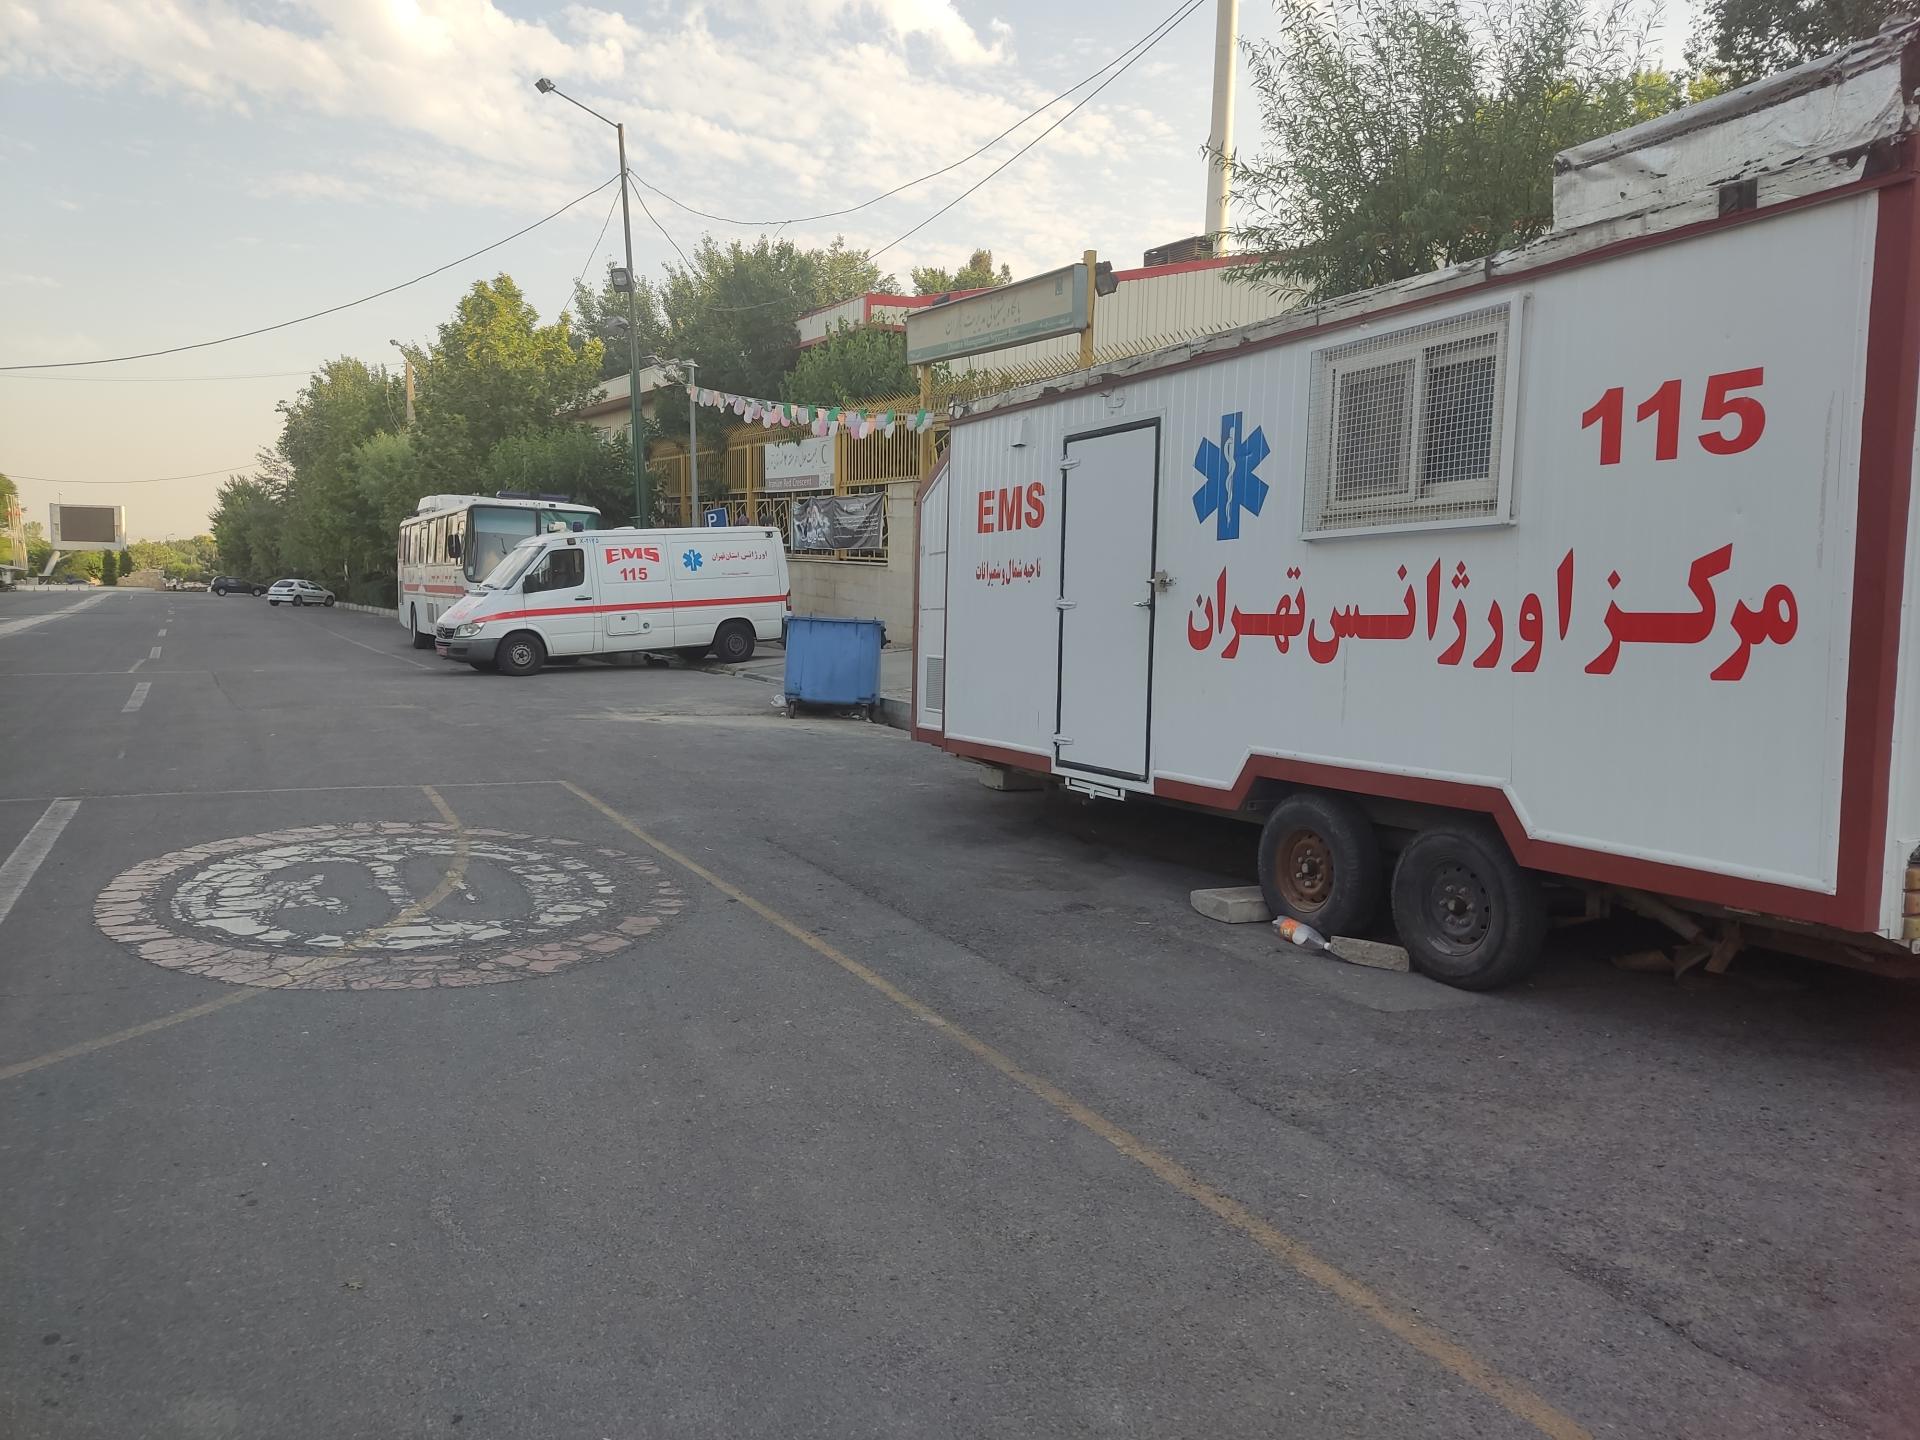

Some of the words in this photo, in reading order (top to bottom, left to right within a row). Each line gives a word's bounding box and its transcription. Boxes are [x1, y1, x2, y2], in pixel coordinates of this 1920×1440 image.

[1581, 366, 1767, 465] 115
[707, 513, 717, 527] P
[977, 481, 1046, 534] EMS
[605, 547, 660, 565] EMS
[711, 552, 726, 562] تهران
[725, 551, 740, 561] استان
[740, 550, 768, 560] اورژانس
[620, 567, 648, 581] 115
[1006, 558, 1023, 585] شمال
[1023, 557, 1042, 583] ناحیه
[1187, 564, 1306, 659] تهران
[1307, 547, 1575, 673] اورژانس
[1585, 542, 1799, 681] مرکز
